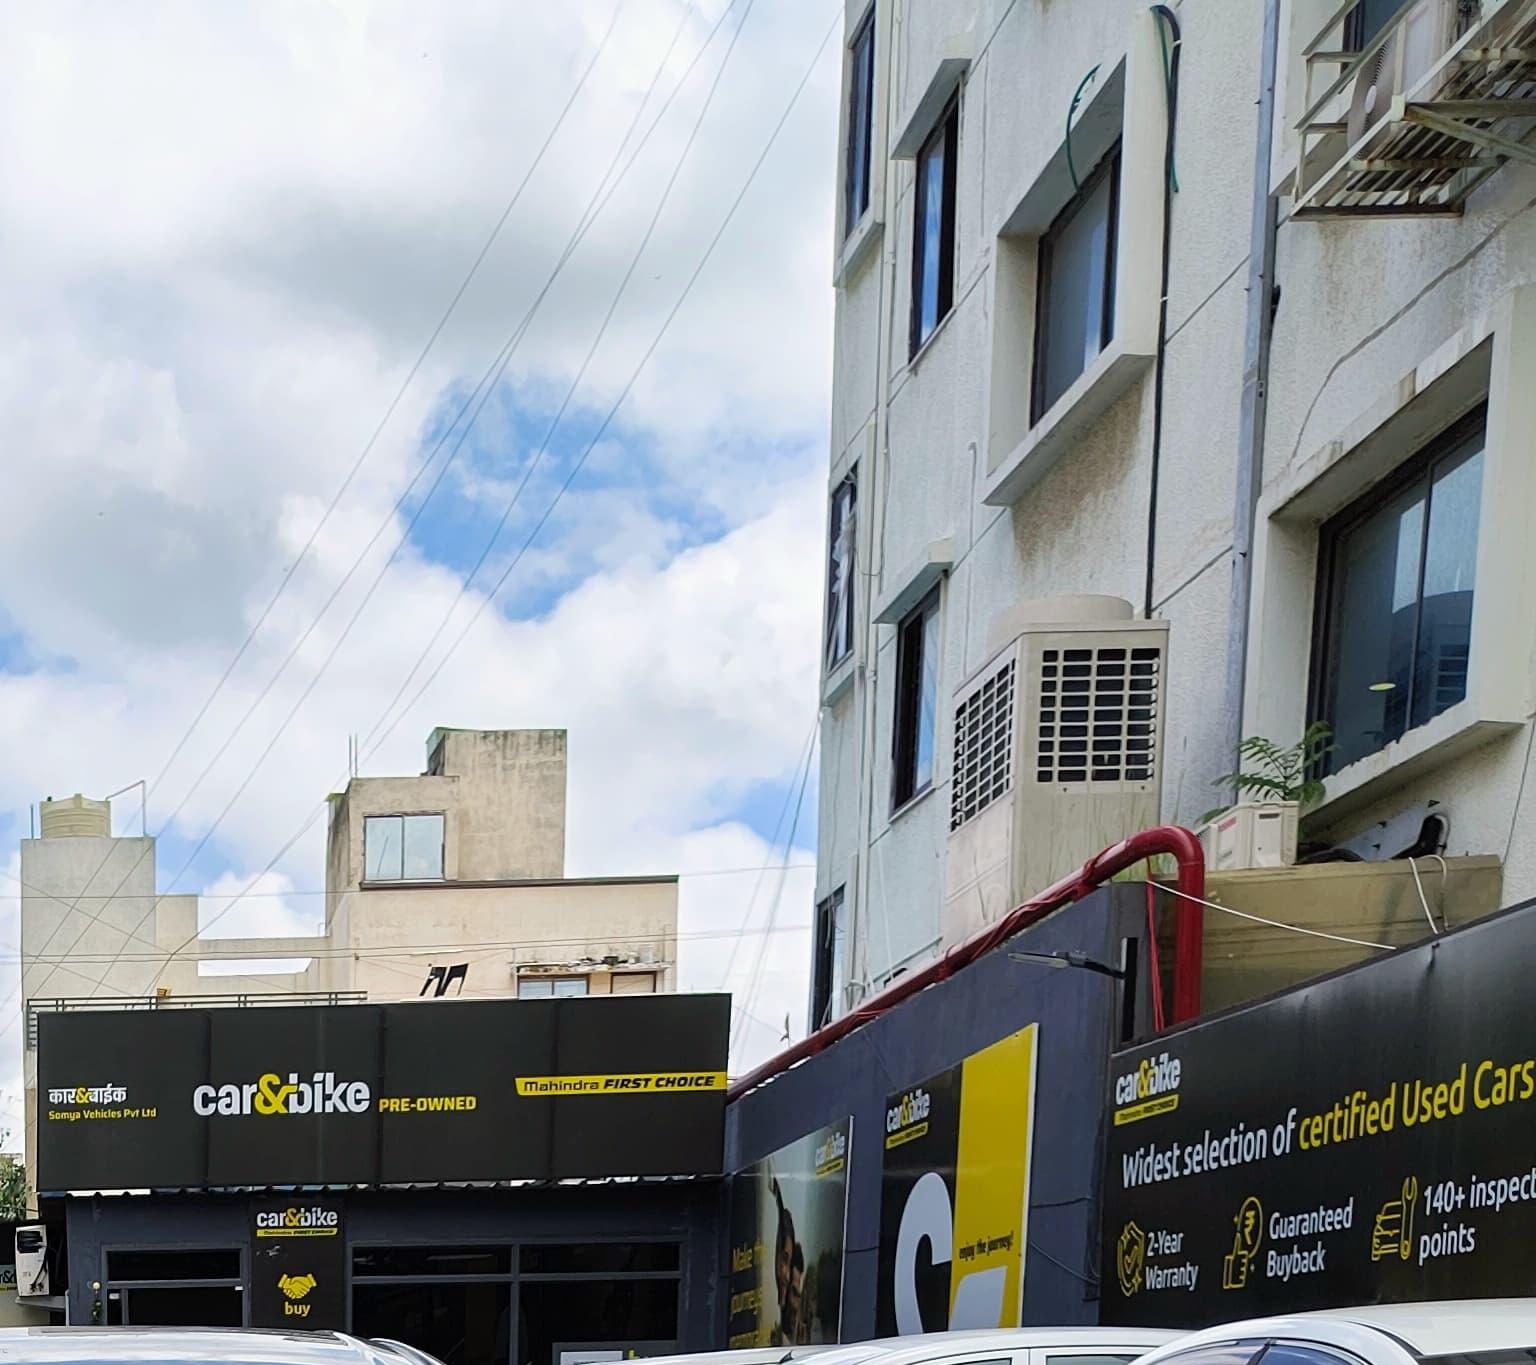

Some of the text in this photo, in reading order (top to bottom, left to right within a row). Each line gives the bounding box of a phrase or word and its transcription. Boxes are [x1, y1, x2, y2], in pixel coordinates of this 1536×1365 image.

[193, 1072, 477, 1116] car&bike PRE-OWNED
[524, 1075, 716, 1092] Mahindra FIRST CHOICE
[1116, 1052, 1181, 1105] car&bike
[83, 1108, 122, 1119] Vehicles
[123, 1108, 140, 1118] Pvt
[141, 1107, 157, 1118] Ltd
[886, 1088, 931, 1133] car&bike
[1122, 1060, 1536, 1188] Widest selection of certified Used Cars
[257, 1207, 338, 1227] car&bike
[1423, 1180, 1466, 1216] 140+
[1268, 1196, 1354, 1240] Guaranteed
[1146, 1229, 1184, 1257] 2-Year
[1266, 1241, 1326, 1283] Buyback
[1418, 1222, 1476, 1267] points
[1146, 1262, 1199, 1291] Warranty
[284, 1301, 311, 1317] buy
